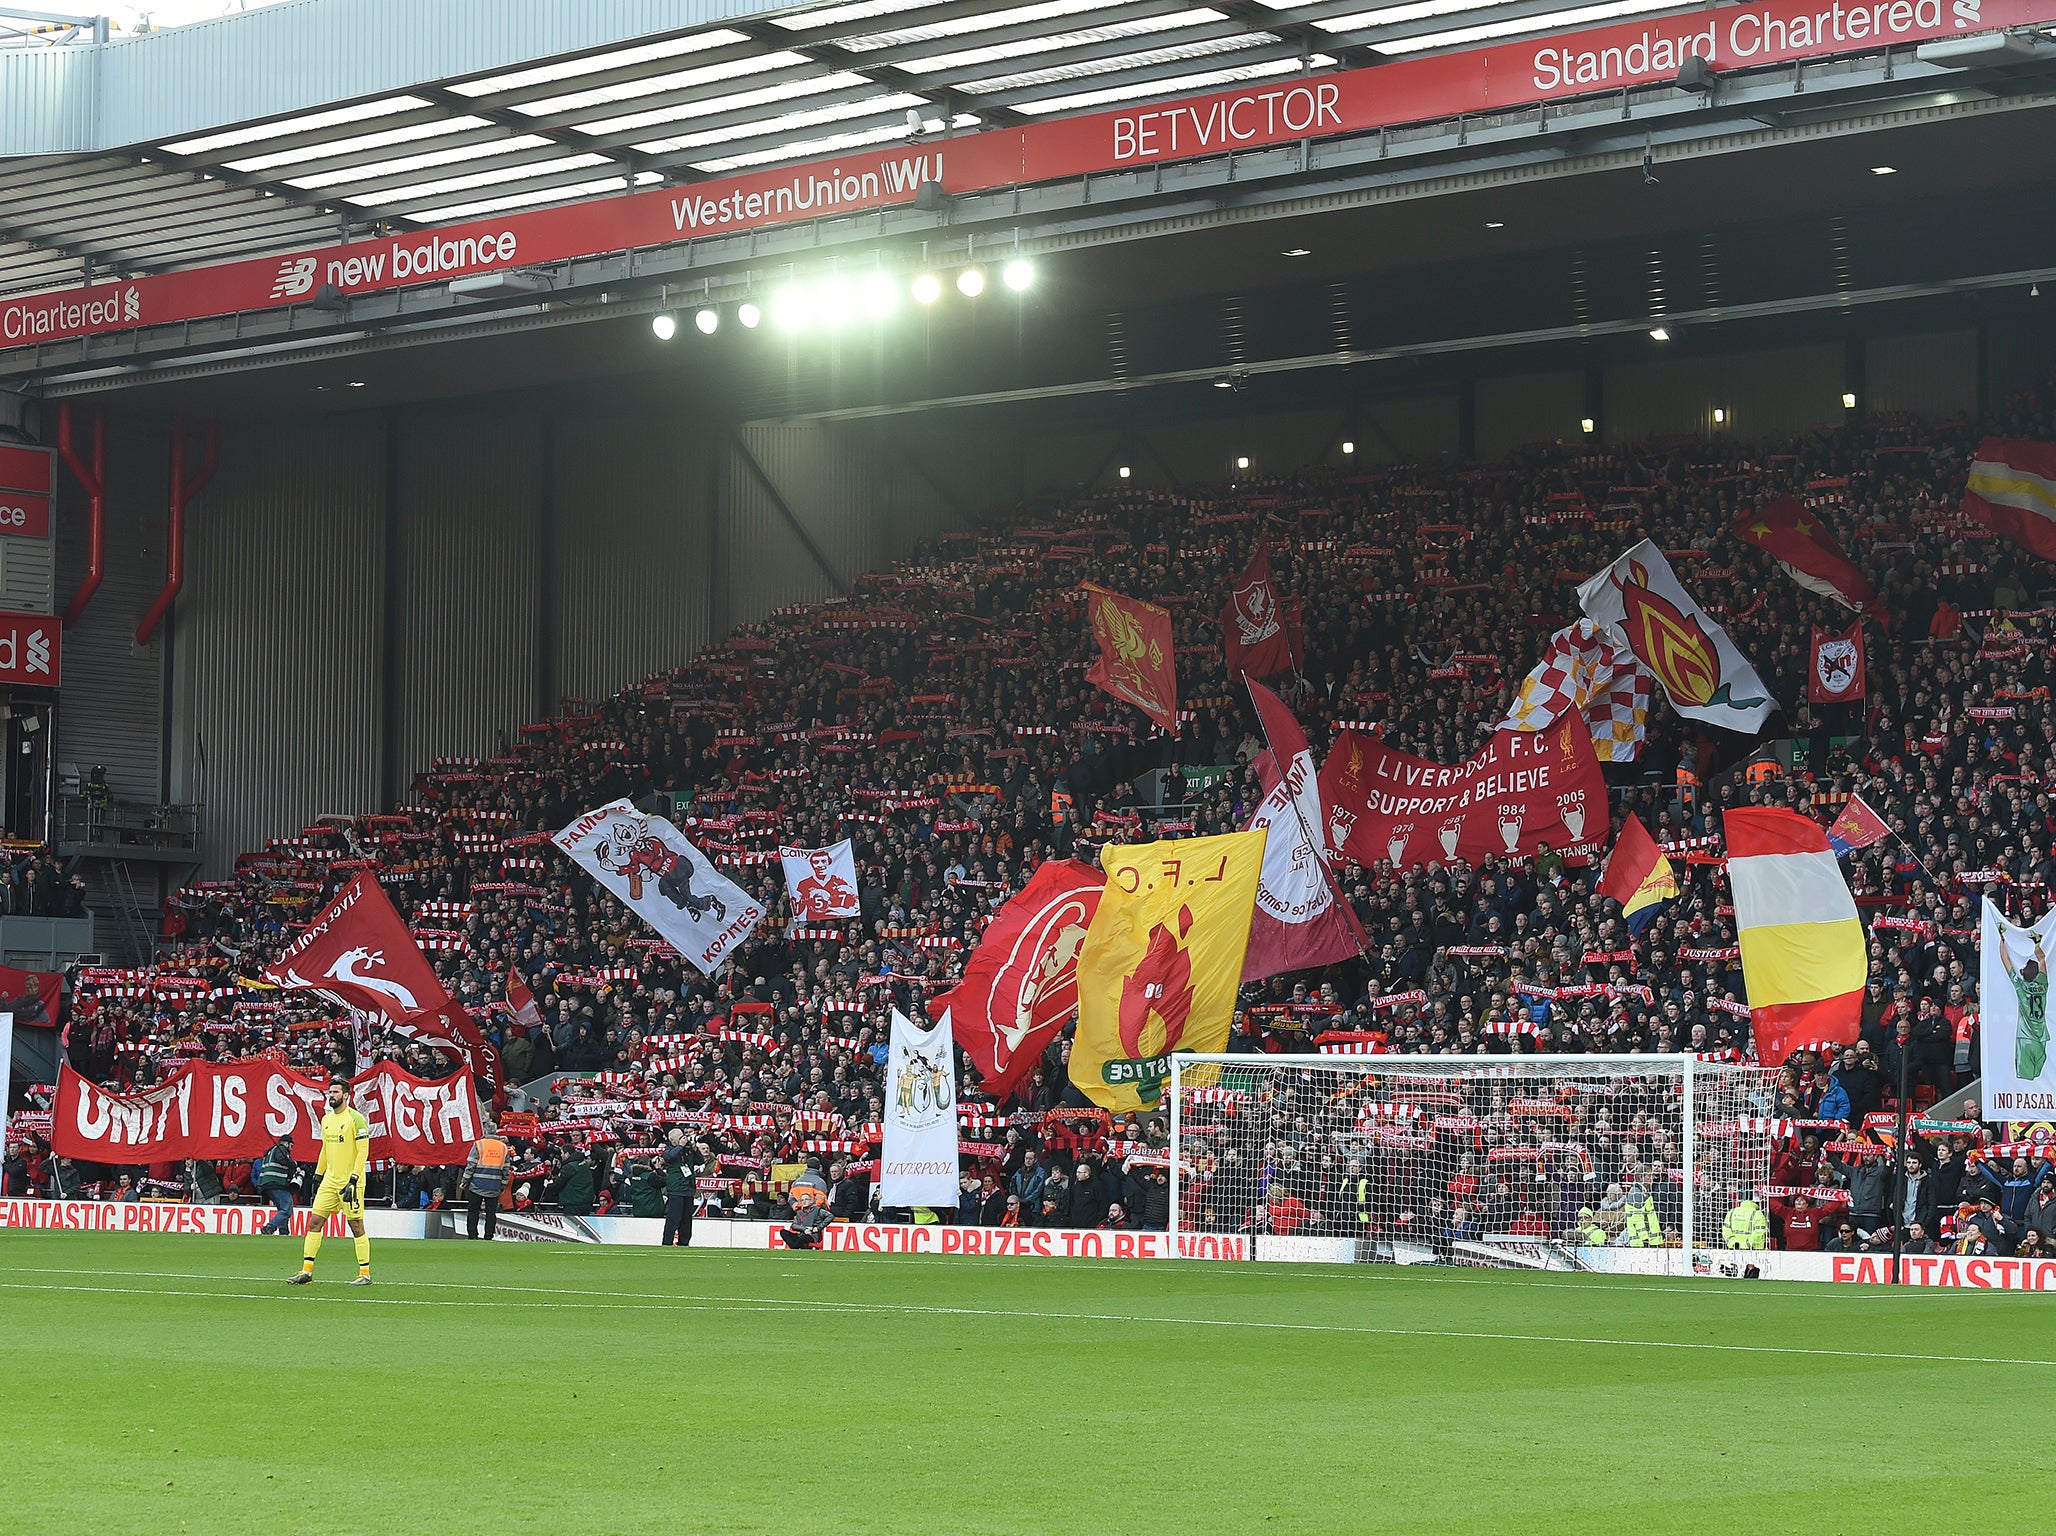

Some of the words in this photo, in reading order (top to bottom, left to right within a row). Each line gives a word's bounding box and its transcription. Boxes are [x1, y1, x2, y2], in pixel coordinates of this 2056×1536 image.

[1532, 20, 1716, 90] Standard
[1729, 0, 1941, 57] Chartered
[1113, 82, 1343, 160] BETVICTOR
[326, 251, 386, 288] new
[392, 231, 517, 278] balance
[2, 291, 120, 340] Chartered
[1377, 743, 1498, 789] LIVERPOOL
[1511, 733, 1549, 758] F.C.
[1186, 777, 1200, 789] XIT
[1366, 789, 1459, 816] SUPPORT
[1459, 790, 1471, 808] &
[1475, 766, 1550, 802] BELIEVE
[1556, 789, 1586, 806] 2005
[1331, 805, 1358, 825] 1977
[1497, 804, 1526, 815] 1984
[559, 803, 629, 850] FAMOS
[780, 848, 812, 861] Cally
[814, 897, 824, 909] 5
[838, 893, 847, 907] 7
[701, 905, 760, 965] KOPITES
[1684, 949, 1722, 958] JUSTICE
[1375, 992, 1411, 1006] LIVERPOOL
[1410, 991, 1419, 1000] FC
[2029, 994, 2045, 1019] 13
[209, 1073, 248, 1138] IS
[664, 1110, 696, 1120] LIVERPOOL
[697, 1111, 710, 1119] FC
[885, 1161, 954, 1176] LIVERPOOL
[1763, 1184, 1786, 1195] ALLEZ
[1787, 1185, 1811, 1197] ALLEZ
[1814, 1188, 1837, 1199] ALLEZ
[123, 1205, 206, 1234] PRIZES
[208, 1207, 243, 1235] TO
[291, 1211, 346, 1238] WN
[494, 1225, 534, 1242] IVERPOOL
[769, 1224, 931, 1254] FTASTIC
[943, 1228, 1055, 1257] PRIZES
[1060, 1232, 1103, 1258] TO
[1114, 1234, 1156, 1259] BE
